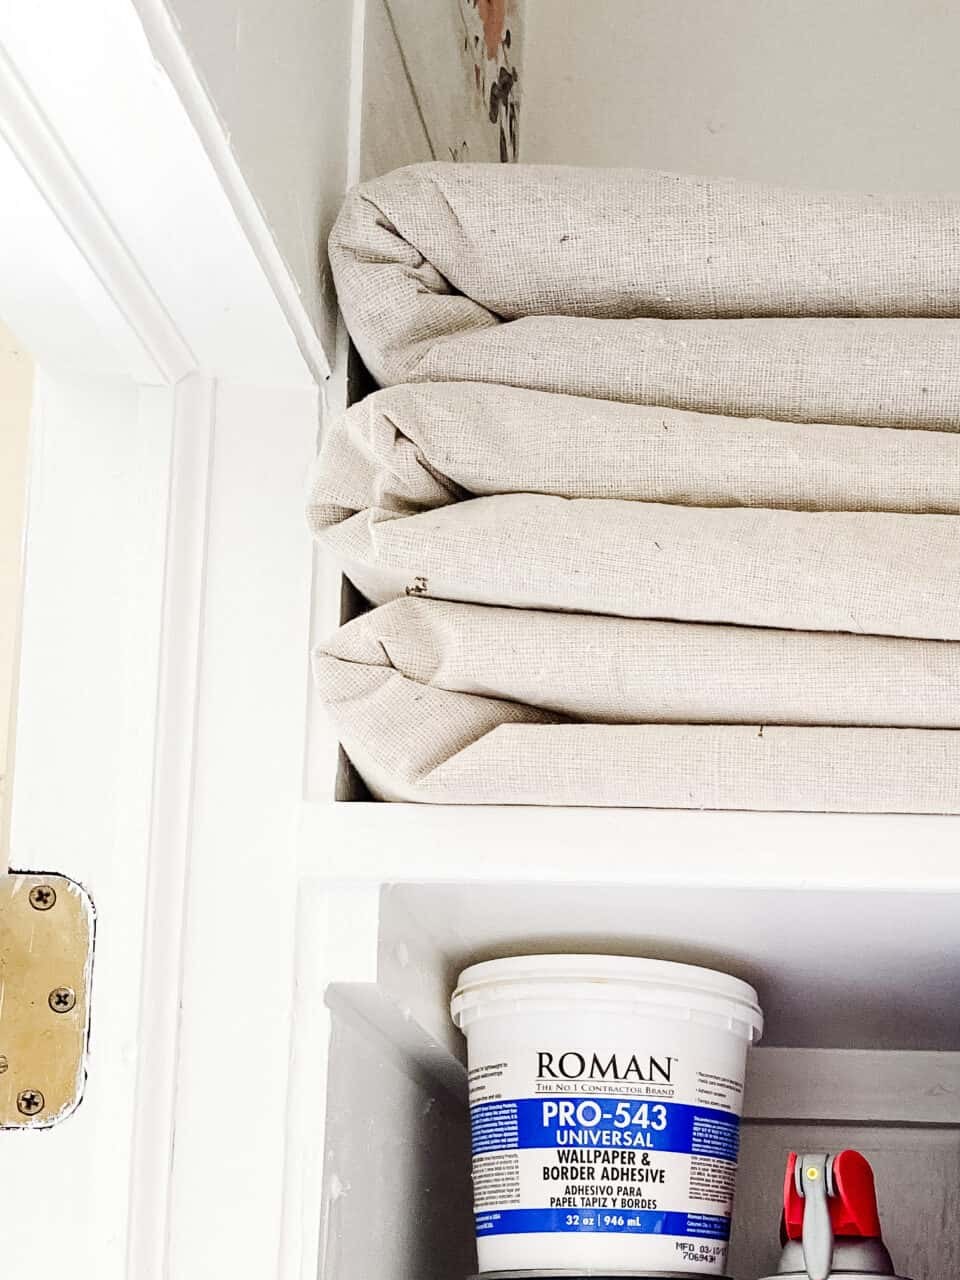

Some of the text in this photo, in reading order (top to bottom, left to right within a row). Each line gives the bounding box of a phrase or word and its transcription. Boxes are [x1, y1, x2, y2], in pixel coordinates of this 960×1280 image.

[536, 1052, 673, 1082] ROMAN
[581, 1084, 642, 1094] CONTRACTOR
[645, 1087, 675, 1095] BRAND
[542, 1101, 667, 1130] PRO-543
[556, 1130, 654, 1148] UNIVERSAL
[557, 1150, 651, 1166] WALLPAPER &
[543, 1166, 665, 1183] BORDER ADHESIVE
[564, 1185, 642, 1196] ADHESIVO PARA
[550, 1197, 657, 1209] PAPEL TAPIZ Y BORDES
[566, 1215, 641, 1226] 32 oz 946 mL
